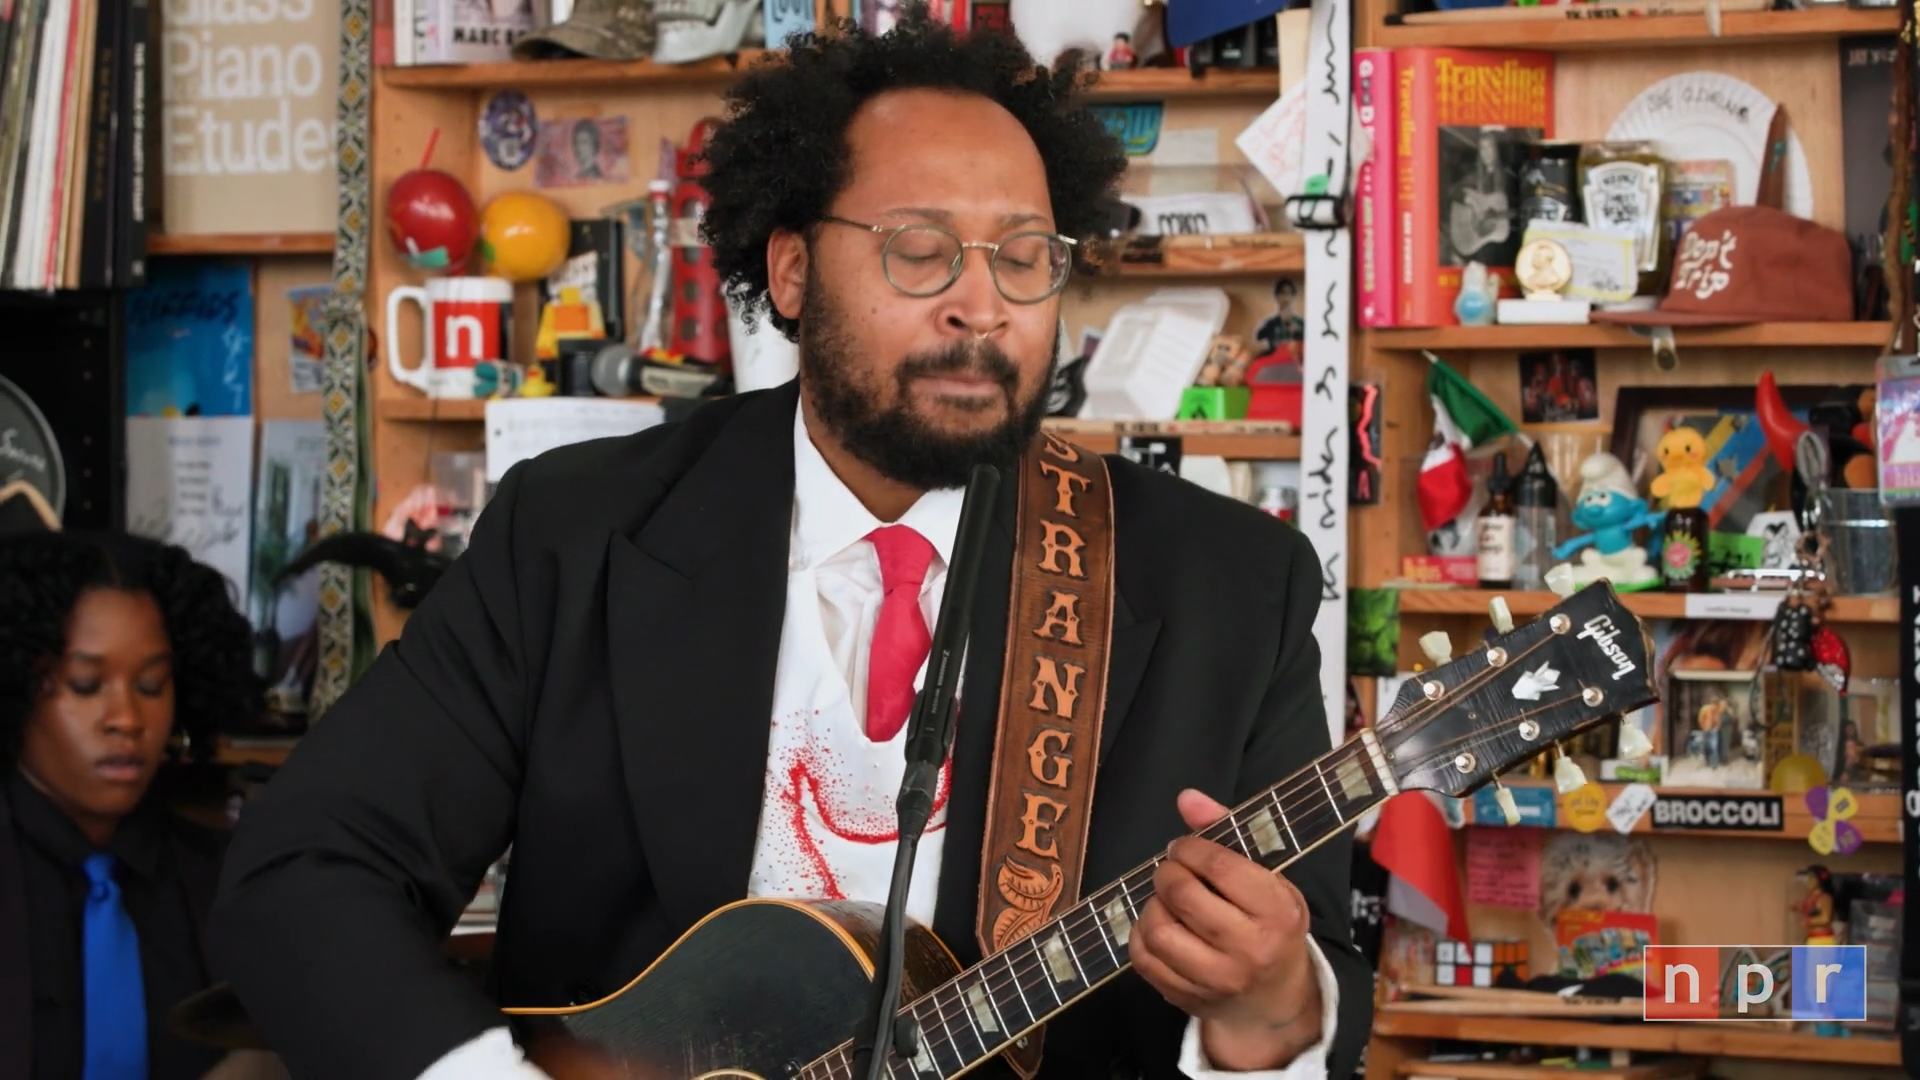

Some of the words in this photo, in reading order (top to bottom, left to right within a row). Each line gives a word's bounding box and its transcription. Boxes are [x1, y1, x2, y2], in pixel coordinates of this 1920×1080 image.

[163, 30, 322, 99] Piano
[1435, 57, 1546, 98] Traveling
[163, 100, 339, 176] Etude
[1399, 65, 1417, 157] Traveling
[1673, 258, 1730, 299] Trip
[1680, 230, 1737, 270] Don't
[1014, 430, 1092, 860] STRANGE
[1576, 614, 1636, 681] Gibson
[1653, 800, 1780, 825] BROCCOLI
